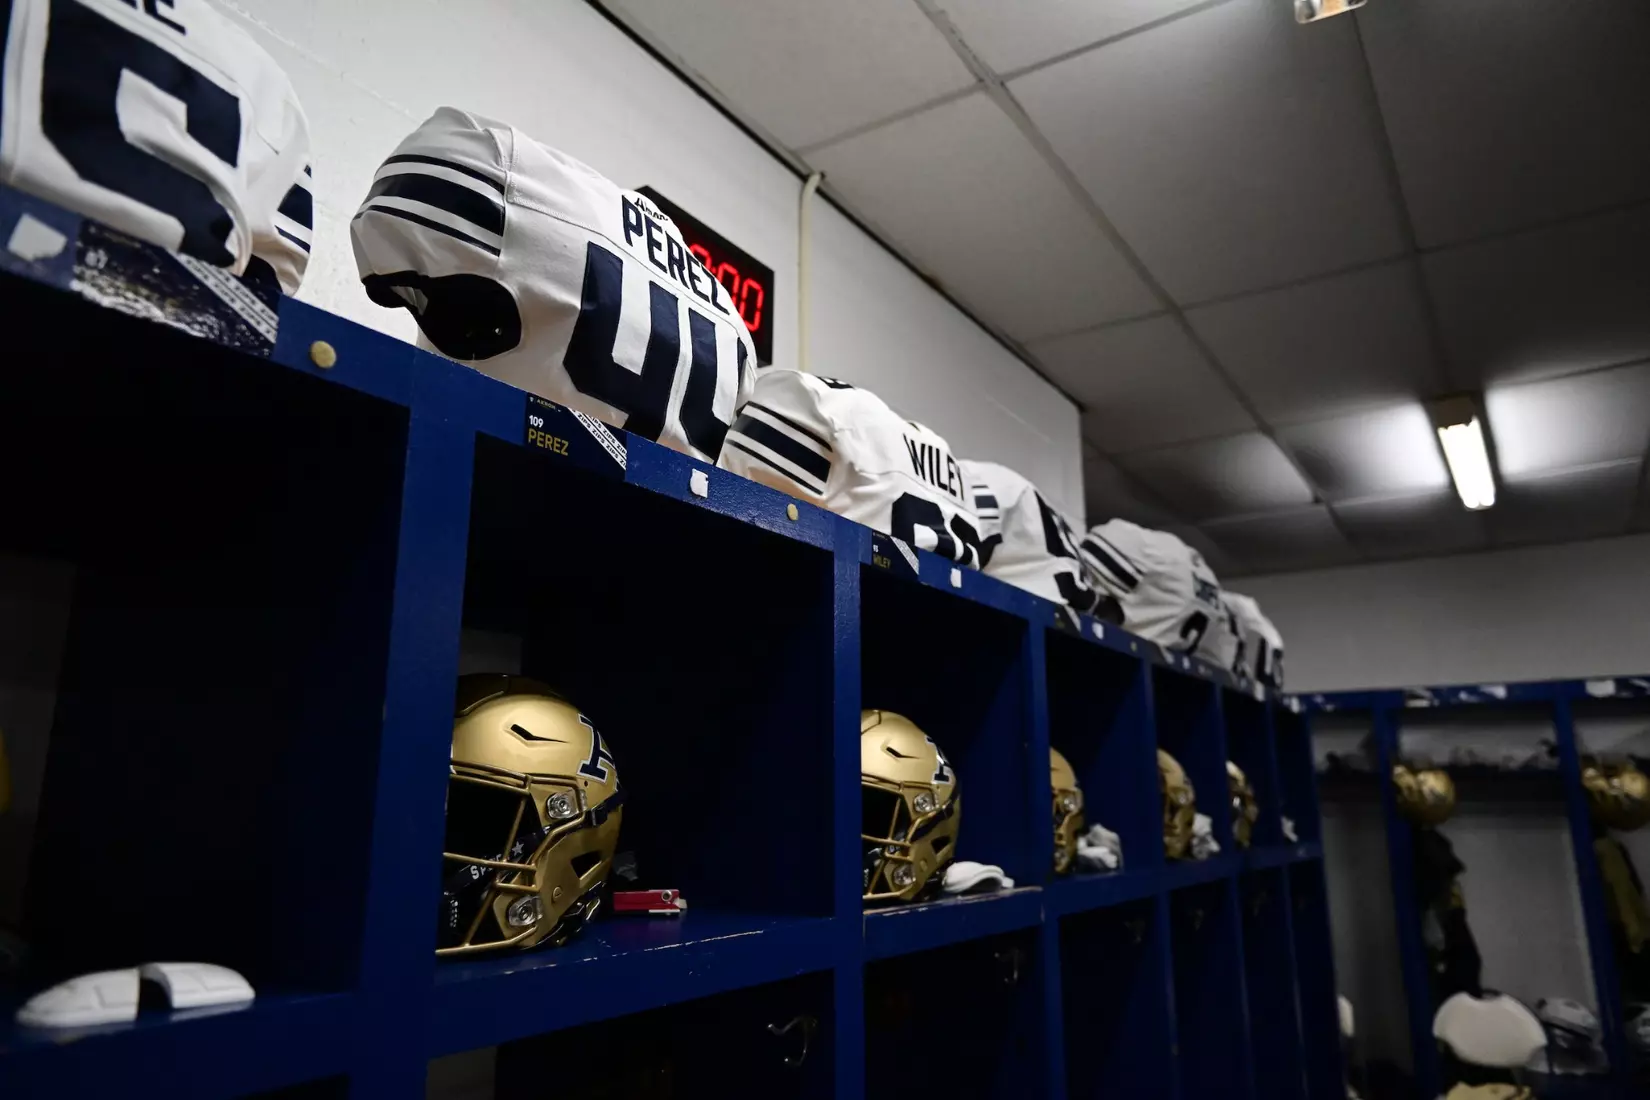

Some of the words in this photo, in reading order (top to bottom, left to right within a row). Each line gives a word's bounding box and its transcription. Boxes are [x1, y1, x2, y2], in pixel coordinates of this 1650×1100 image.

[621, 194, 730, 316] PEREZ
[529, 415, 544, 428] 109
[528, 428, 569, 456] PEREZ
